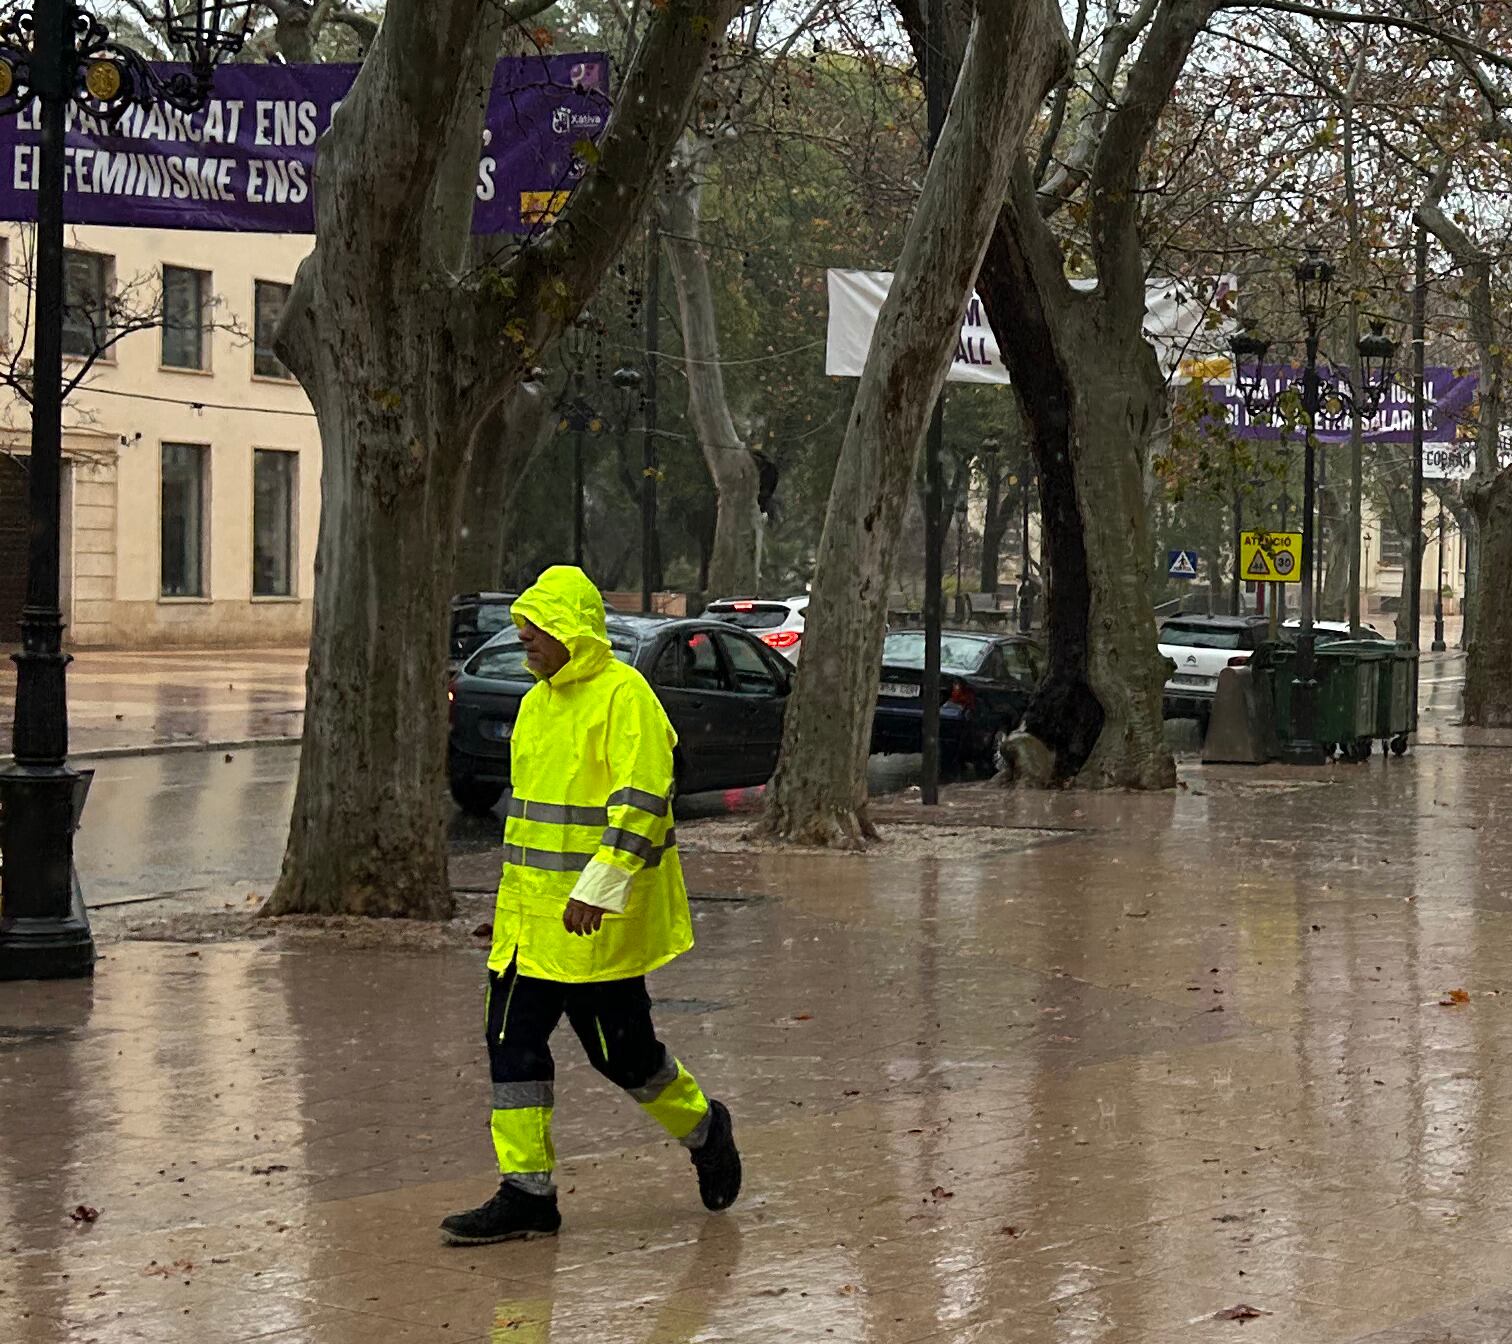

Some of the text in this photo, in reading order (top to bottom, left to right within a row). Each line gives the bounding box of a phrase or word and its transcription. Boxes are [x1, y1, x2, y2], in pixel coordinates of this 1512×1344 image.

[255, 100, 318, 146] ENS
[64, 148, 237, 202] FEMINISME
[246, 159, 309, 204] ENS
[1278, 557, 1291, 567] 30
